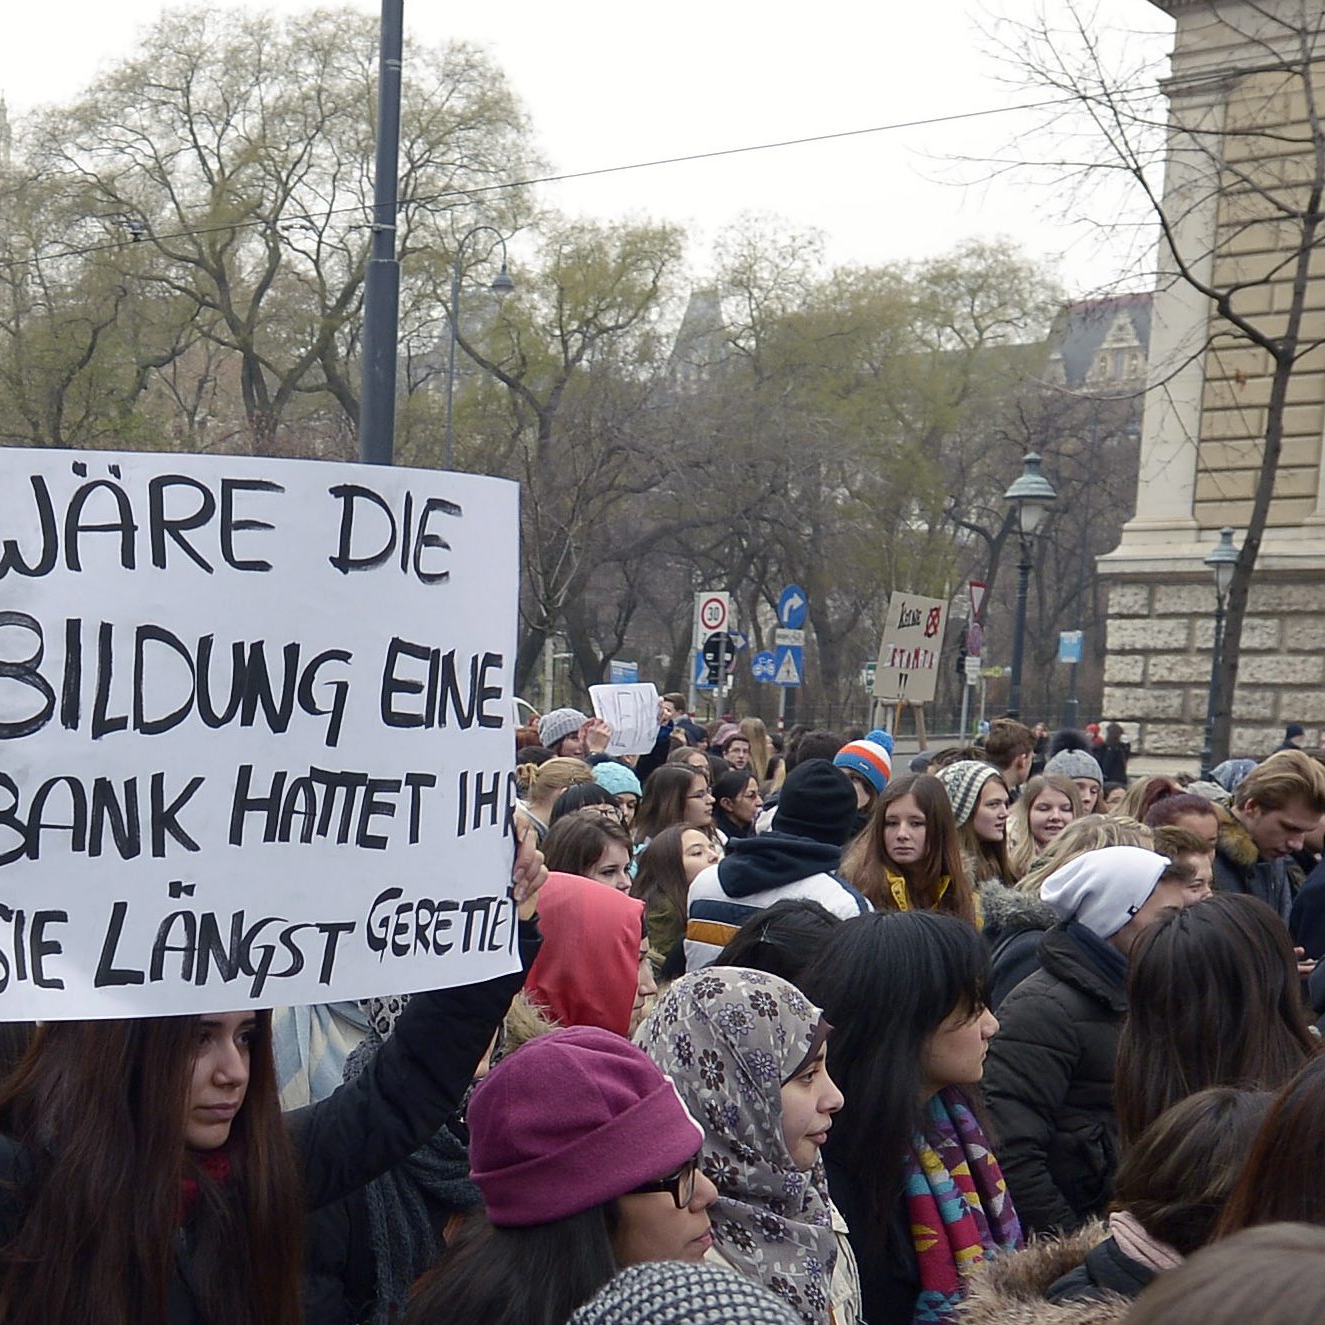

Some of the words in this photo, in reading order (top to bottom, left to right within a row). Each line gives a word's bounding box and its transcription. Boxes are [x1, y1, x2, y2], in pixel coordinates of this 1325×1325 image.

[329, 484, 461, 583] DIE
[707, 606, 720, 621] 30
[381, 637, 503, 730] EINE
[229, 765, 436, 849] HATTET
[95, 881, 357, 999] LÄNGST
